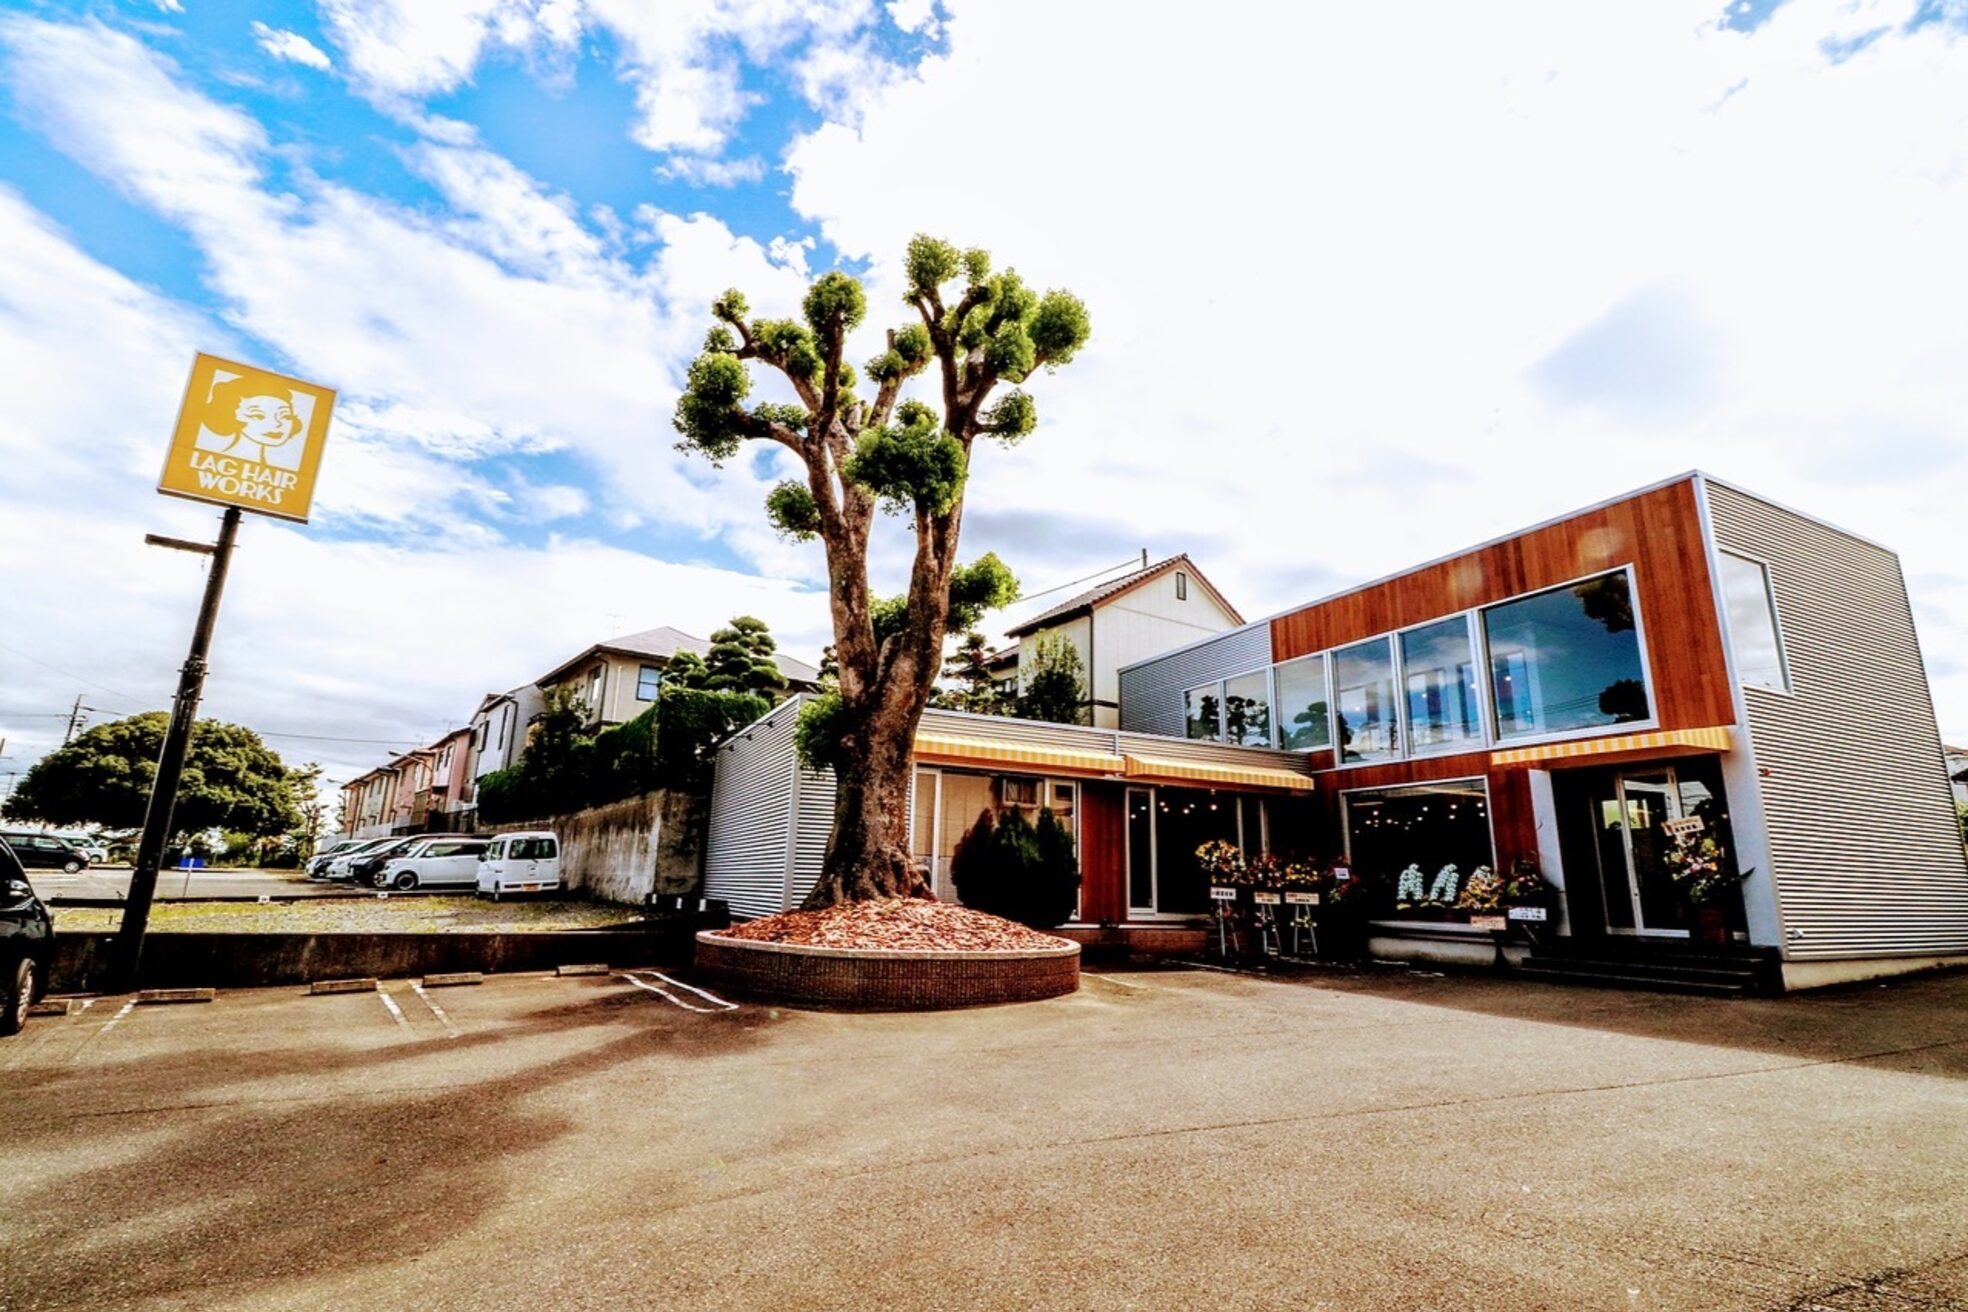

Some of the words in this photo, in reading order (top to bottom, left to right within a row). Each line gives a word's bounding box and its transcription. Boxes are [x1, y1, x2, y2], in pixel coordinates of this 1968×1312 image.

[190, 451, 238, 476] LAG
[241, 463, 298, 490] HAIR
[198, 470, 285, 504] WORKS
